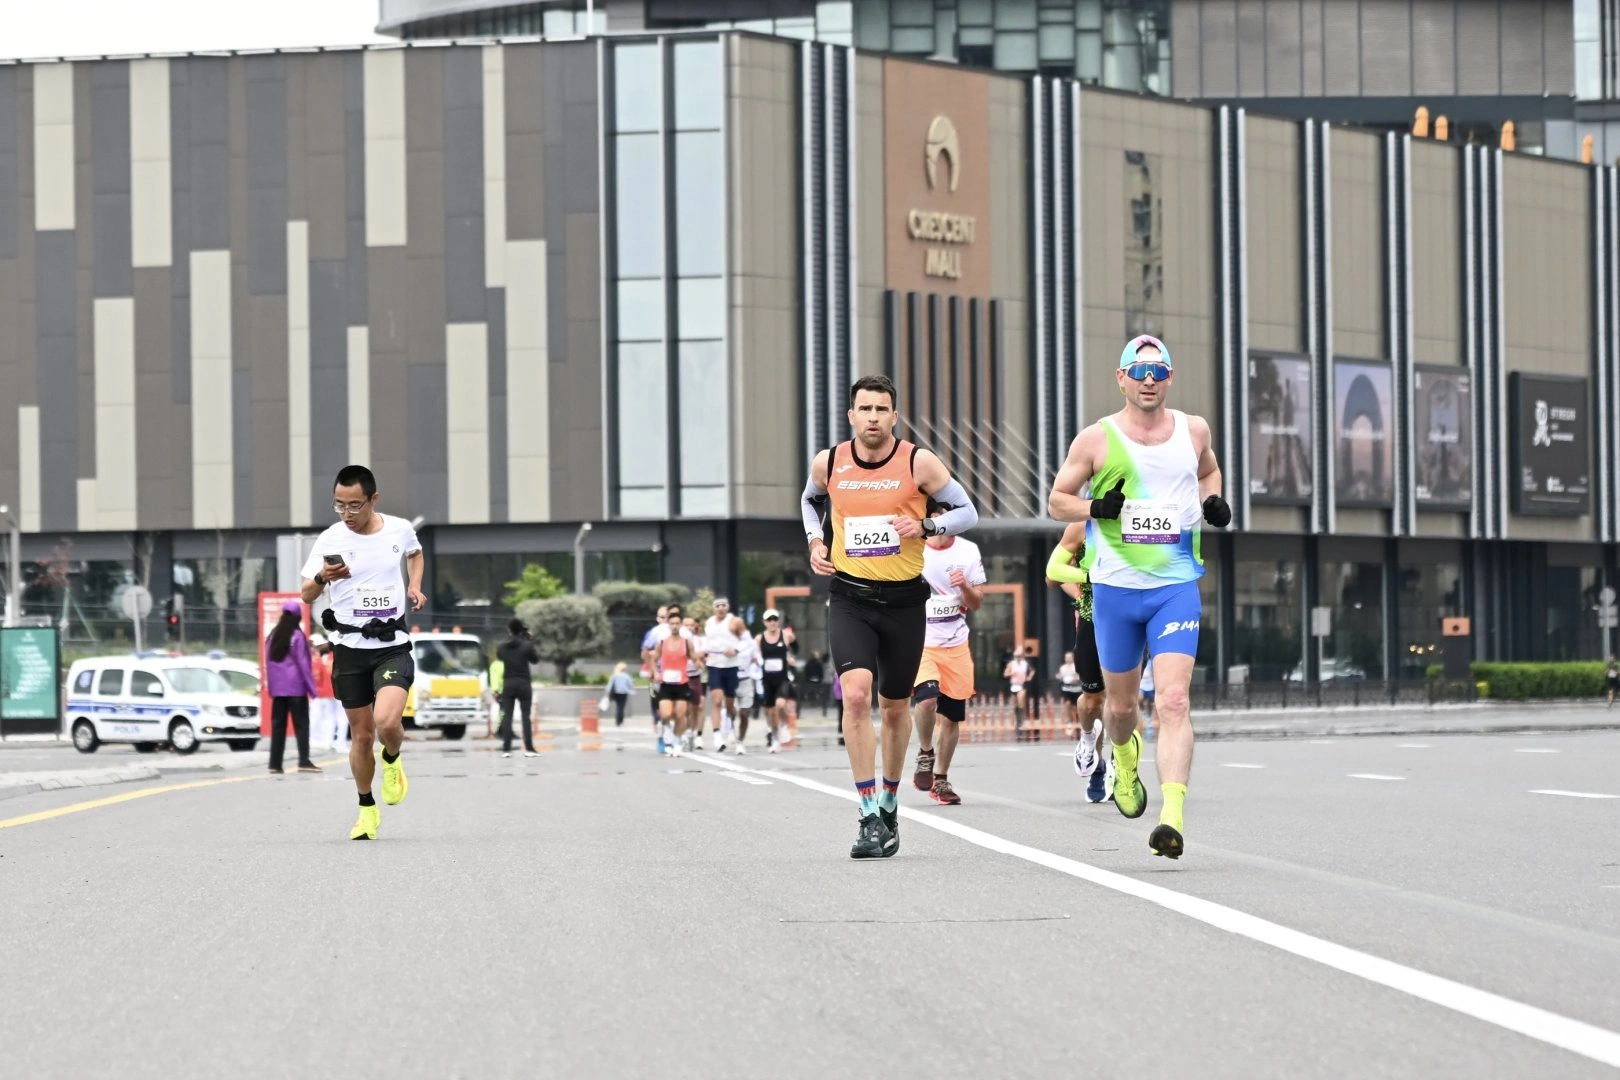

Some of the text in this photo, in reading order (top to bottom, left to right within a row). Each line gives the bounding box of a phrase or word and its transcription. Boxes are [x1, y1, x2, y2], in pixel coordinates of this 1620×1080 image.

[909, 208, 976, 243] CRESCENT
[925, 248, 963, 279] MALL
[836, 478, 902, 491] ESPAÑA
[1132, 517, 1172, 531] 5436
[854, 531, 890, 546] 5624
[363, 596, 390, 608] 5315
